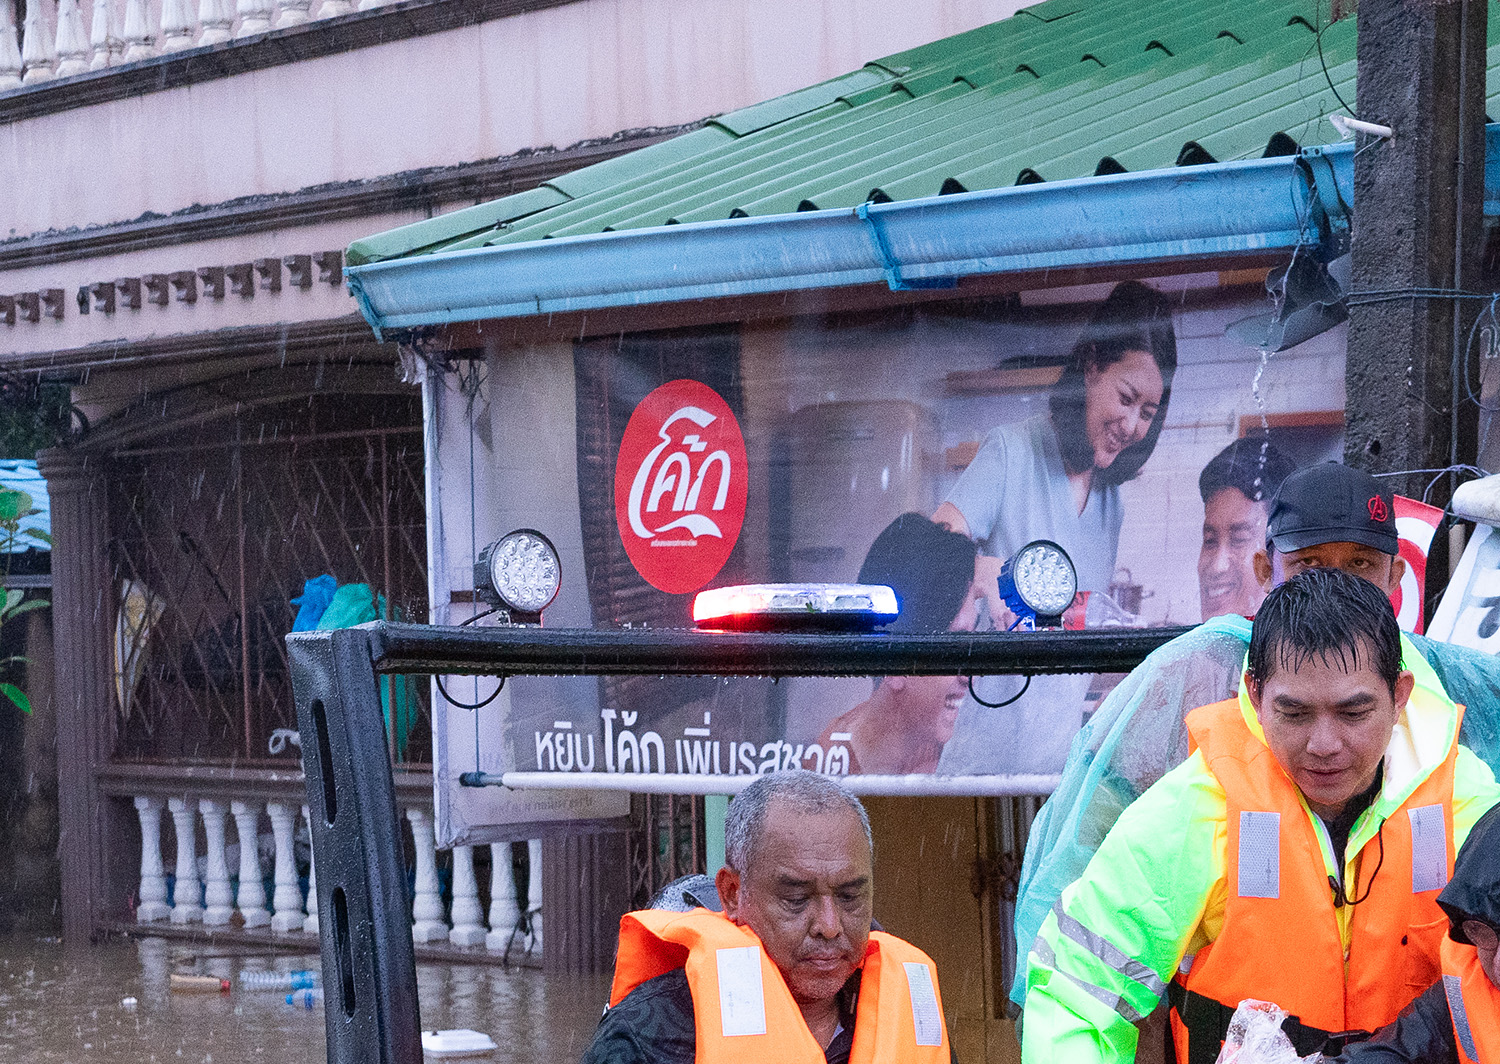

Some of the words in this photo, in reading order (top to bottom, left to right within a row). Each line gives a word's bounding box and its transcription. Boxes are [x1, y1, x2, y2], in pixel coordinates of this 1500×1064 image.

[628, 406, 731, 538] โค้ก
[534, 720, 595, 774] หยิบ
[600, 708, 666, 774] โค้ก
